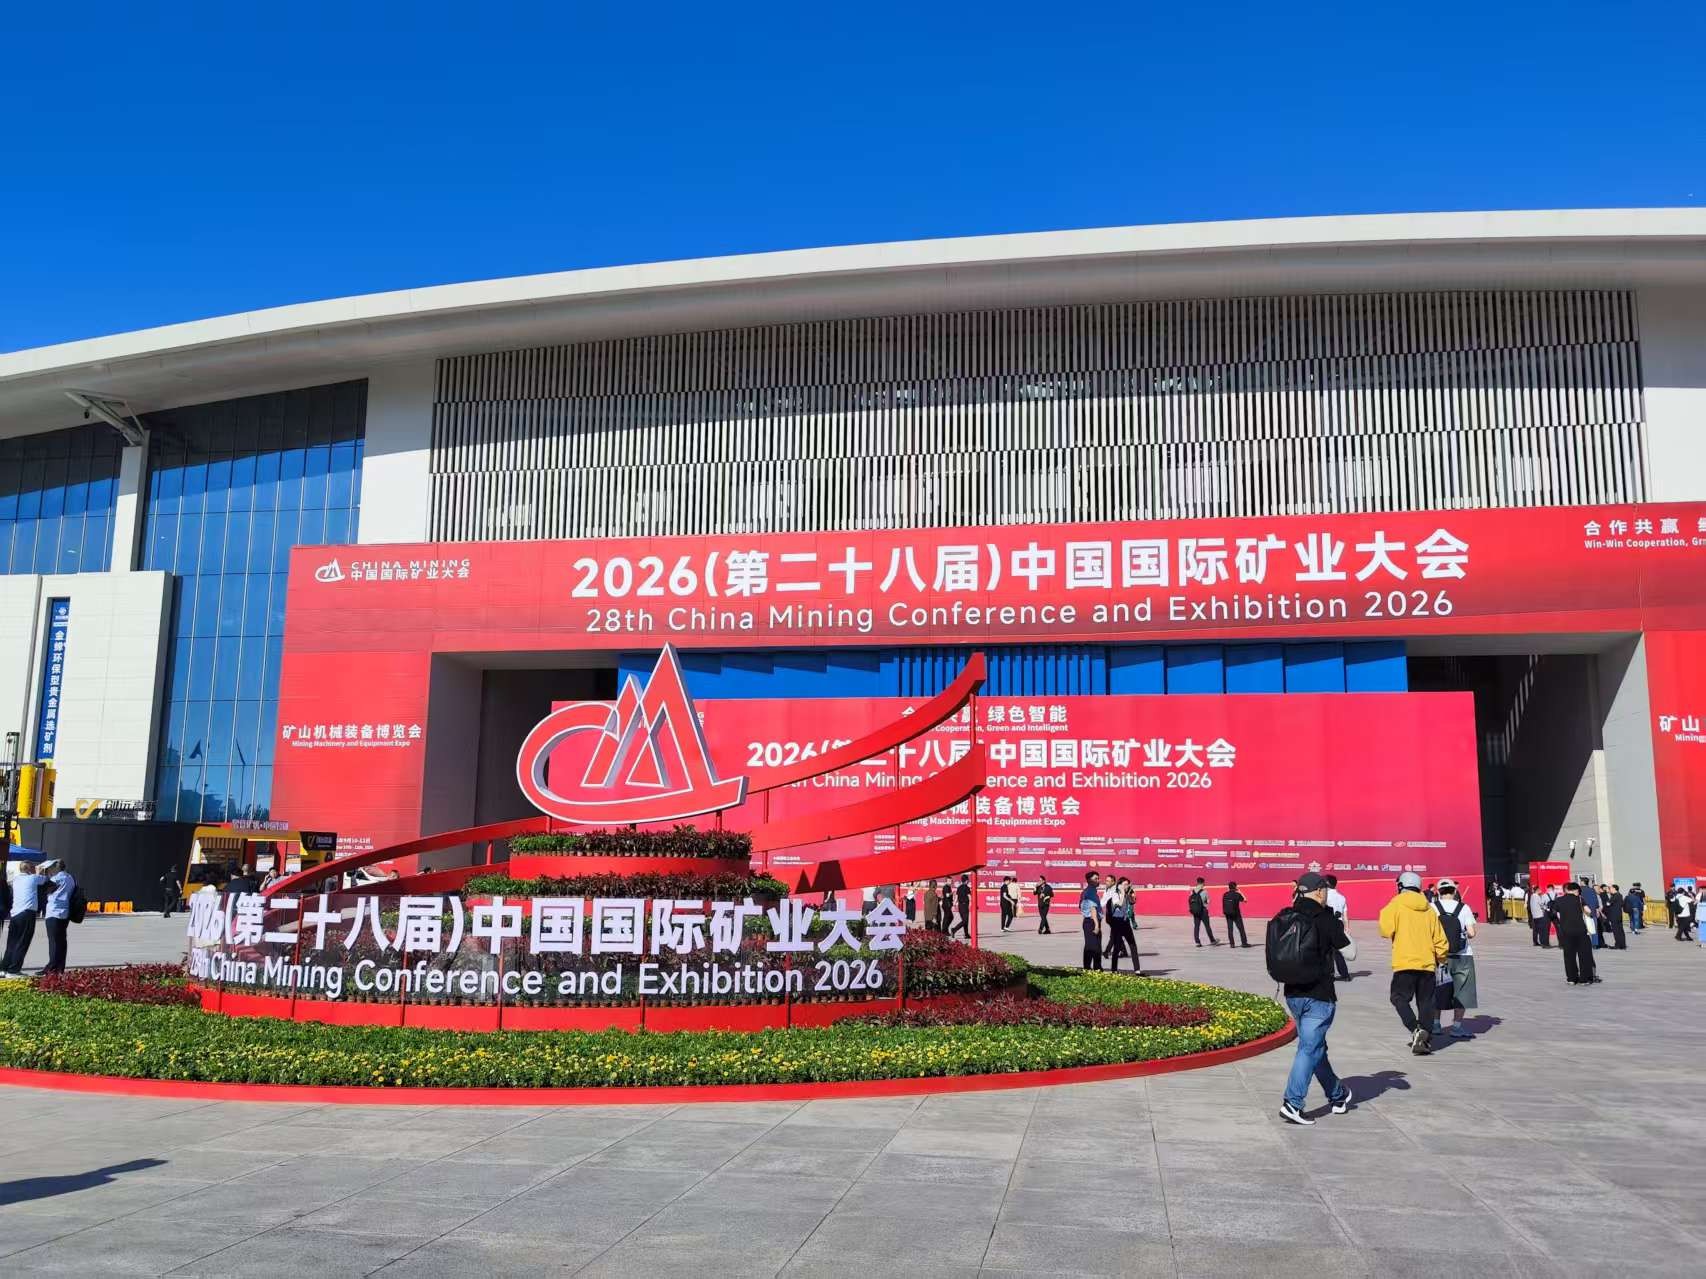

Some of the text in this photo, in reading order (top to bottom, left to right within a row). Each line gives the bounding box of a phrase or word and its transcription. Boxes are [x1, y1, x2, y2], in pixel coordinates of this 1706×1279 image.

[1583, 518, 1680, 536] 合作共赢
[1584, 539, 1624, 549] Win-Win
[1626, 537, 1688, 549] Cooperation,
[351, 558, 470, 569] CHINA MINING
[571, 528, 1469, 598] 2026(第二十八届)中国国际矿业大会
[351, 567, 470, 581] 中国国际矿业大会
[587, 590, 1453, 633] 28th China Mining Conference and Exhibition 2026
[986, 704, 1068, 723] 绿色智能
[282, 724, 422, 740] 矿山机械装备博览会
[935, 723, 985, 733] Cooperatn,
[1012, 724, 1027, 732] and
[1028, 723, 1068, 734] Intelligent
[746, 738, 1236, 769] 2026十八届中国国际矿业大会
[811, 771, 860, 788] China
[866, 771, 923, 788] Minng
[1034, 772, 1066, 788] and
[1072, 771, 1161, 788] Exhibition
[1167, 772, 1213, 788] 2026
[940, 796, 1080, 818] 械装备博览会
[995, 817, 1042, 828] Equipment
[1044, 818, 1066, 828] Expo
[187, 892, 906, 956] 2026(第二十八届)中国国际矿业大会
[211, 951, 257, 984] China
[263, 955, 343, 998] Mining
[354, 959, 544, 995] Conference
[559, 963, 622, 995] and
[638, 962, 803, 995] Exhibition
[814, 959, 883, 991] 2026
